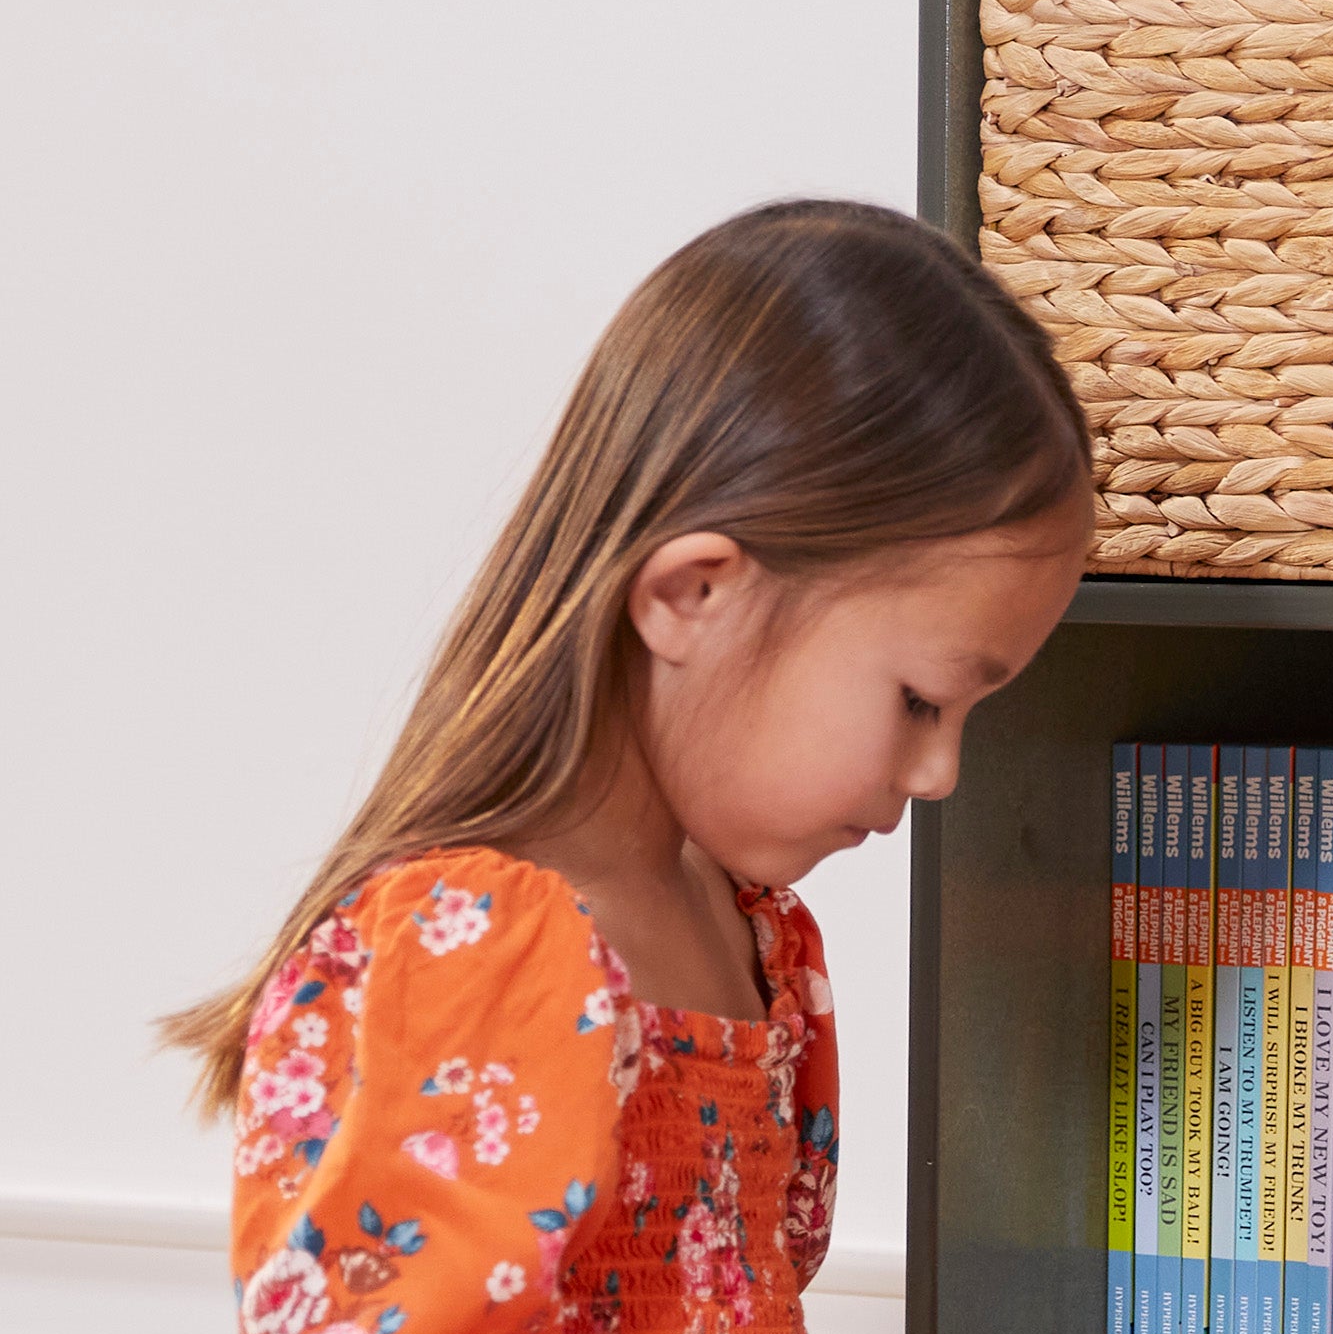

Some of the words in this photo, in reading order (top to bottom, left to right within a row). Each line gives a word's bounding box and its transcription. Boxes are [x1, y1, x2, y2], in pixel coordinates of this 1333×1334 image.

[1116, 771, 1132, 854] Willems
[1191, 776, 1208, 859] Willems
[1268, 776, 1285, 859] Willems
[1191, 979, 1203, 991] A
[1267, 988, 1279, 1030] WILL
[1163, 996, 1179, 1033] MY
[1190, 999, 1203, 1033] BIG
[1242, 987, 1256, 1059] LISTEN
[1315, 1005, 1331, 1072] LOVE
[1115, 1003, 1129, 1094] REALLY
[1141, 1021, 1154, 1064] CAN
[1190, 1040, 1202, 1080] GUY
[1293, 1020, 1308, 1090] BROKE
[1162, 1041, 1179, 1136] FRIEND
[1219, 1061, 1231, 1094] AM
[1242, 1066, 1255, 1093] TO
[1265, 1041, 1278, 1134] SURPRISE
[1314, 1081, 1329, 1118] MY
[1115, 1100, 1128, 1153] LIKE
[1140, 1085, 1154, 1137] PLAY
[1189, 1087, 1202, 1142] TOOK
[1241, 1099, 1254, 1129] MY
[1292, 1102, 1305, 1134] MY
[1161, 1146, 1177, 1168] IS
[1189, 1148, 1201, 1178] MY
[1217, 1101, 1231, 1178] GOING!
[1265, 1141, 1276, 1168] MY
[1312, 1127, 1328, 1186] NEW
[1113, 1161, 1127, 1223] SLOP!
[1140, 1144, 1153, 1196] TOO?
[1239, 1135, 1253, 1241] TRUMPET!
[1290, 1140, 1305, 1222] TRUNK!
[1161, 1176, 1177, 1226] SAD
[1187, 1186, 1200, 1245] BALL!
[1263, 1176, 1276, 1251] FRIEND!
[1310, 1194, 1326, 1254] TOY!
